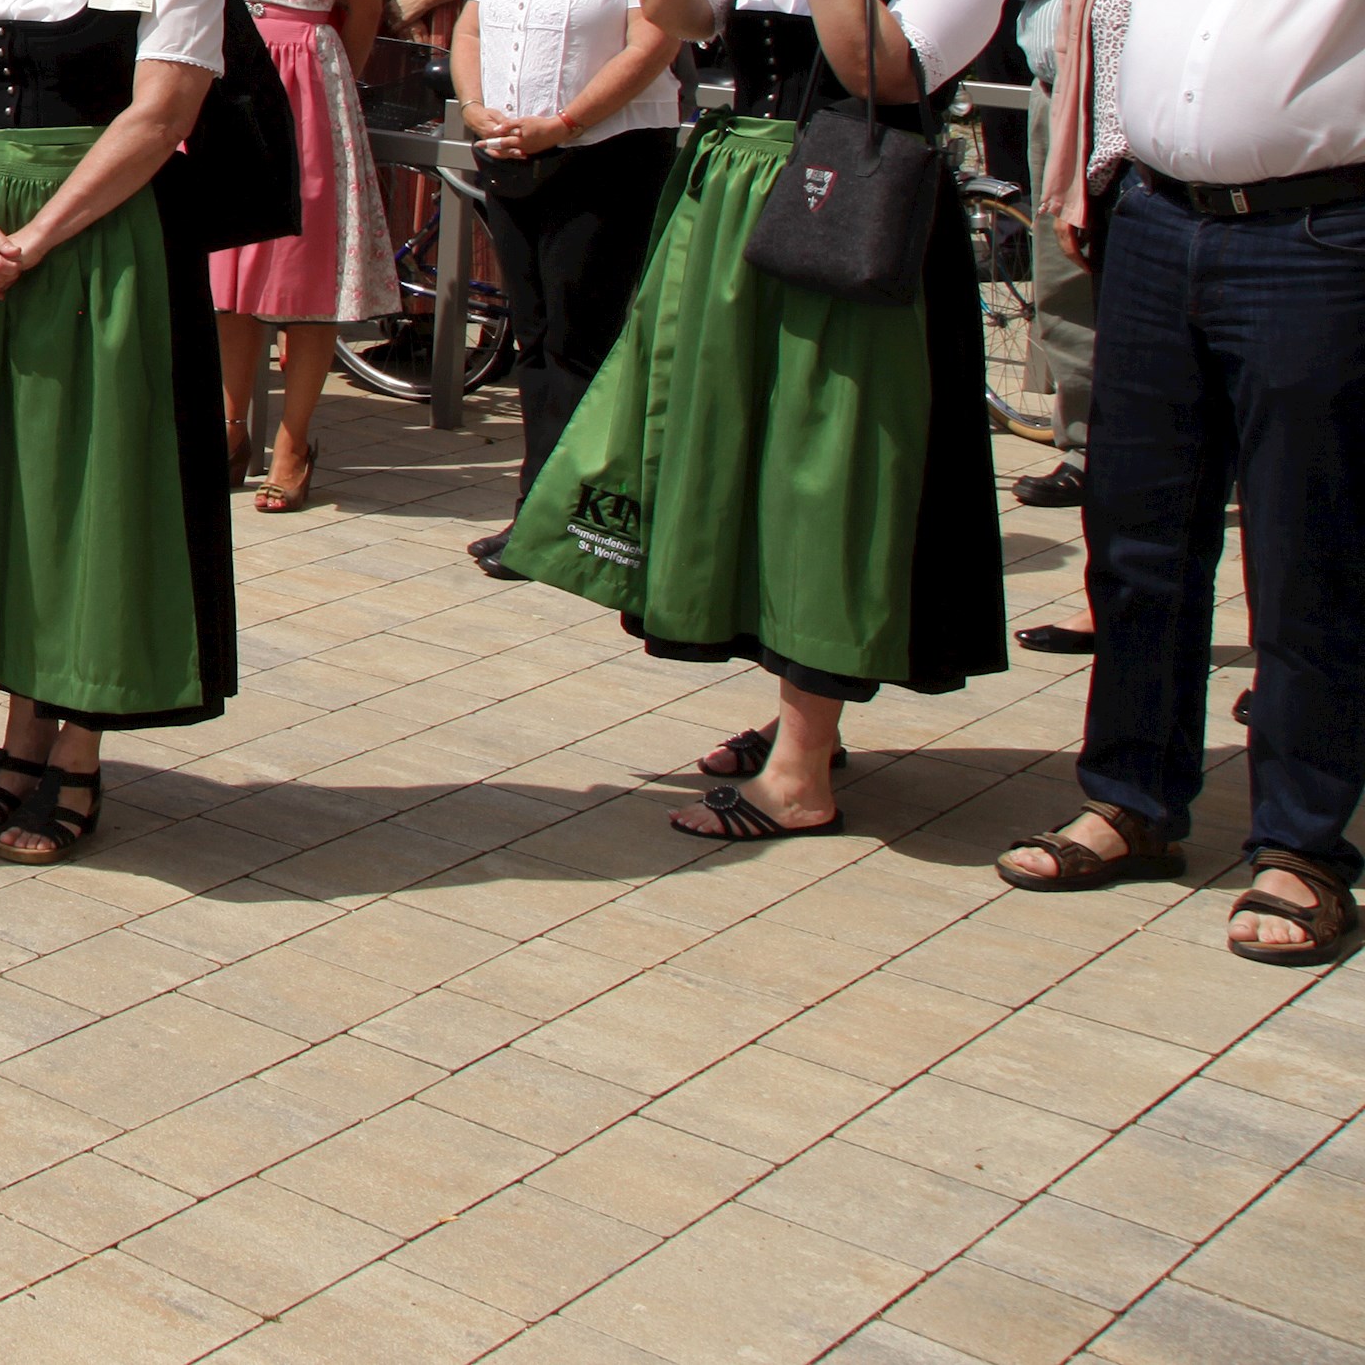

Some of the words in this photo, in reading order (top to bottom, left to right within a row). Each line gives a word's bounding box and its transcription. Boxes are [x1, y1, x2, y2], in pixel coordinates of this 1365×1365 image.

[566, 524, 642, 555] Gemeindebüch
[578, 539, 592, 553] St.
[594, 545, 641, 569] Wolfgang
